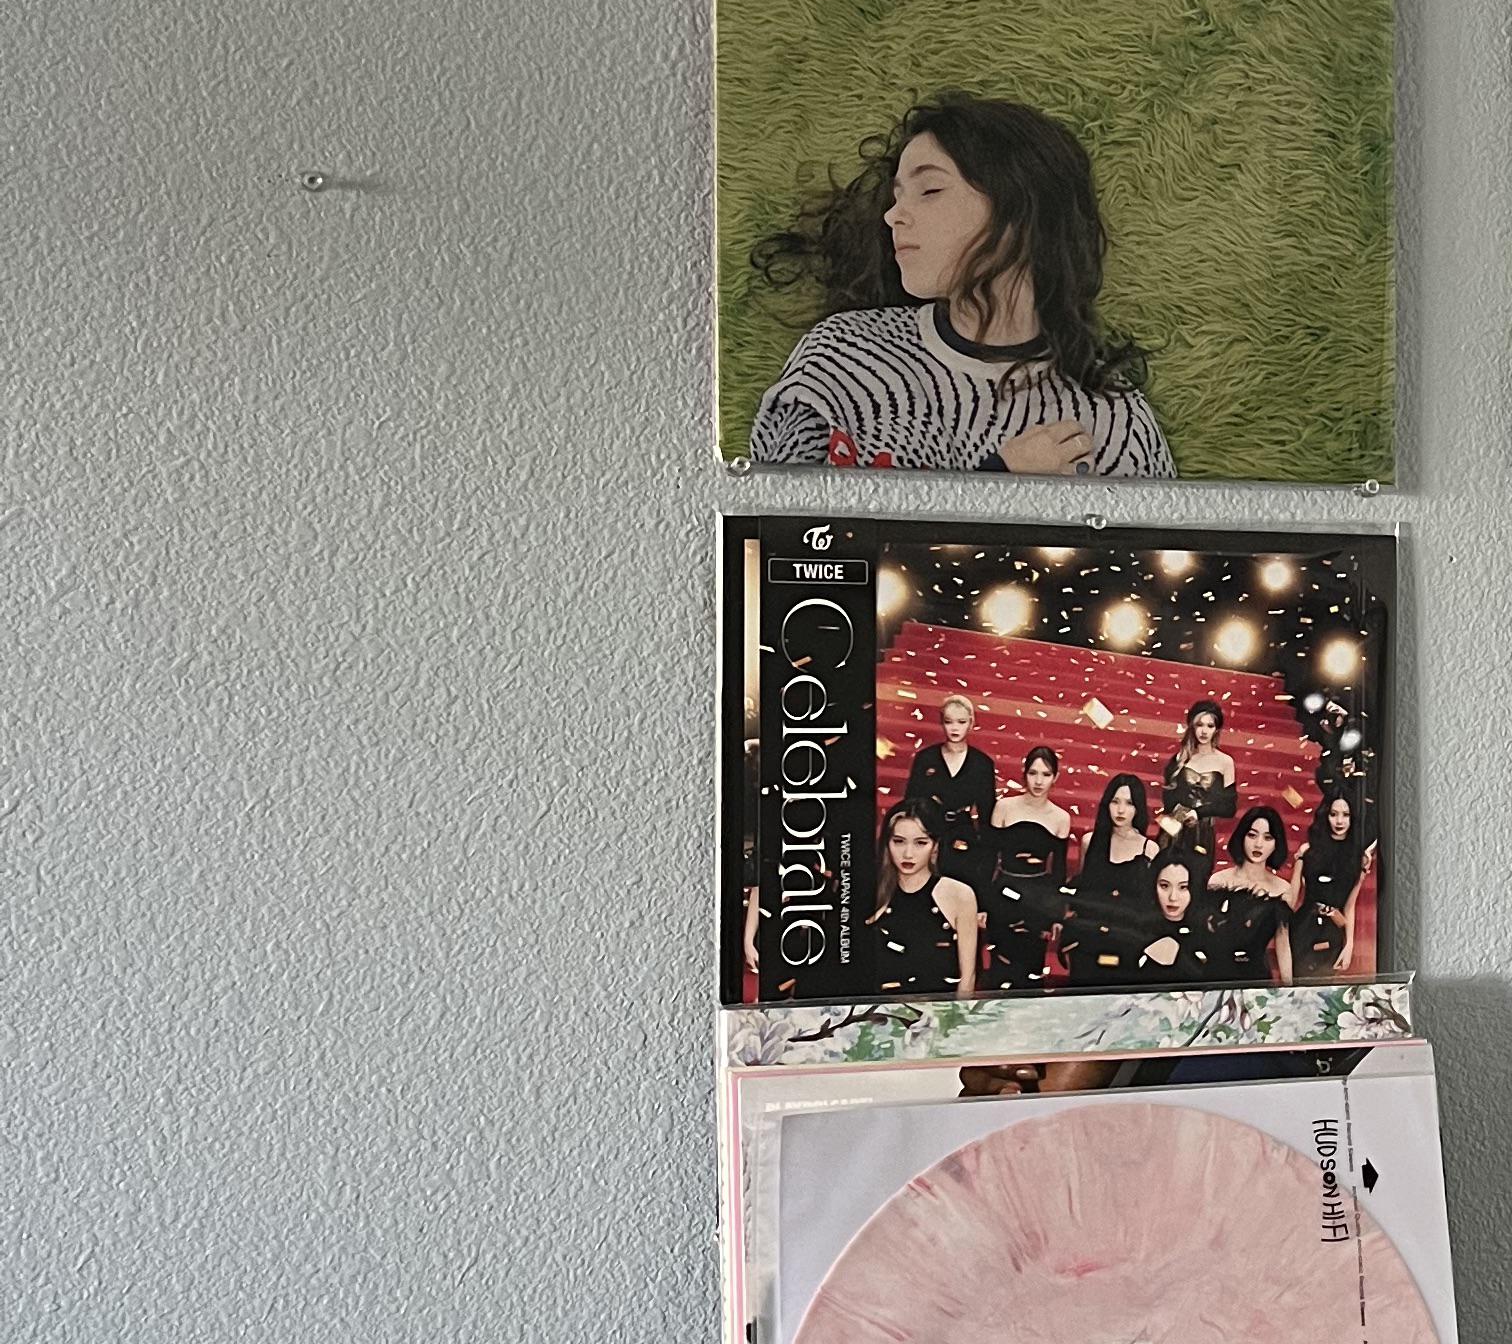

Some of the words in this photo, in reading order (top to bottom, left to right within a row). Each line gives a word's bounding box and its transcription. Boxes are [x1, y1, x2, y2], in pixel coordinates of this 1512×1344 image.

[792, 563, 844, 580] TWICE
[779, 597, 855, 966] Celebrate
[842, 832, 852, 867] TWICE
[841, 868, 851, 904] JAPAN
[840, 924, 850, 965] ALBUM
[1312, 1119, 1340, 1198] HUDSON
